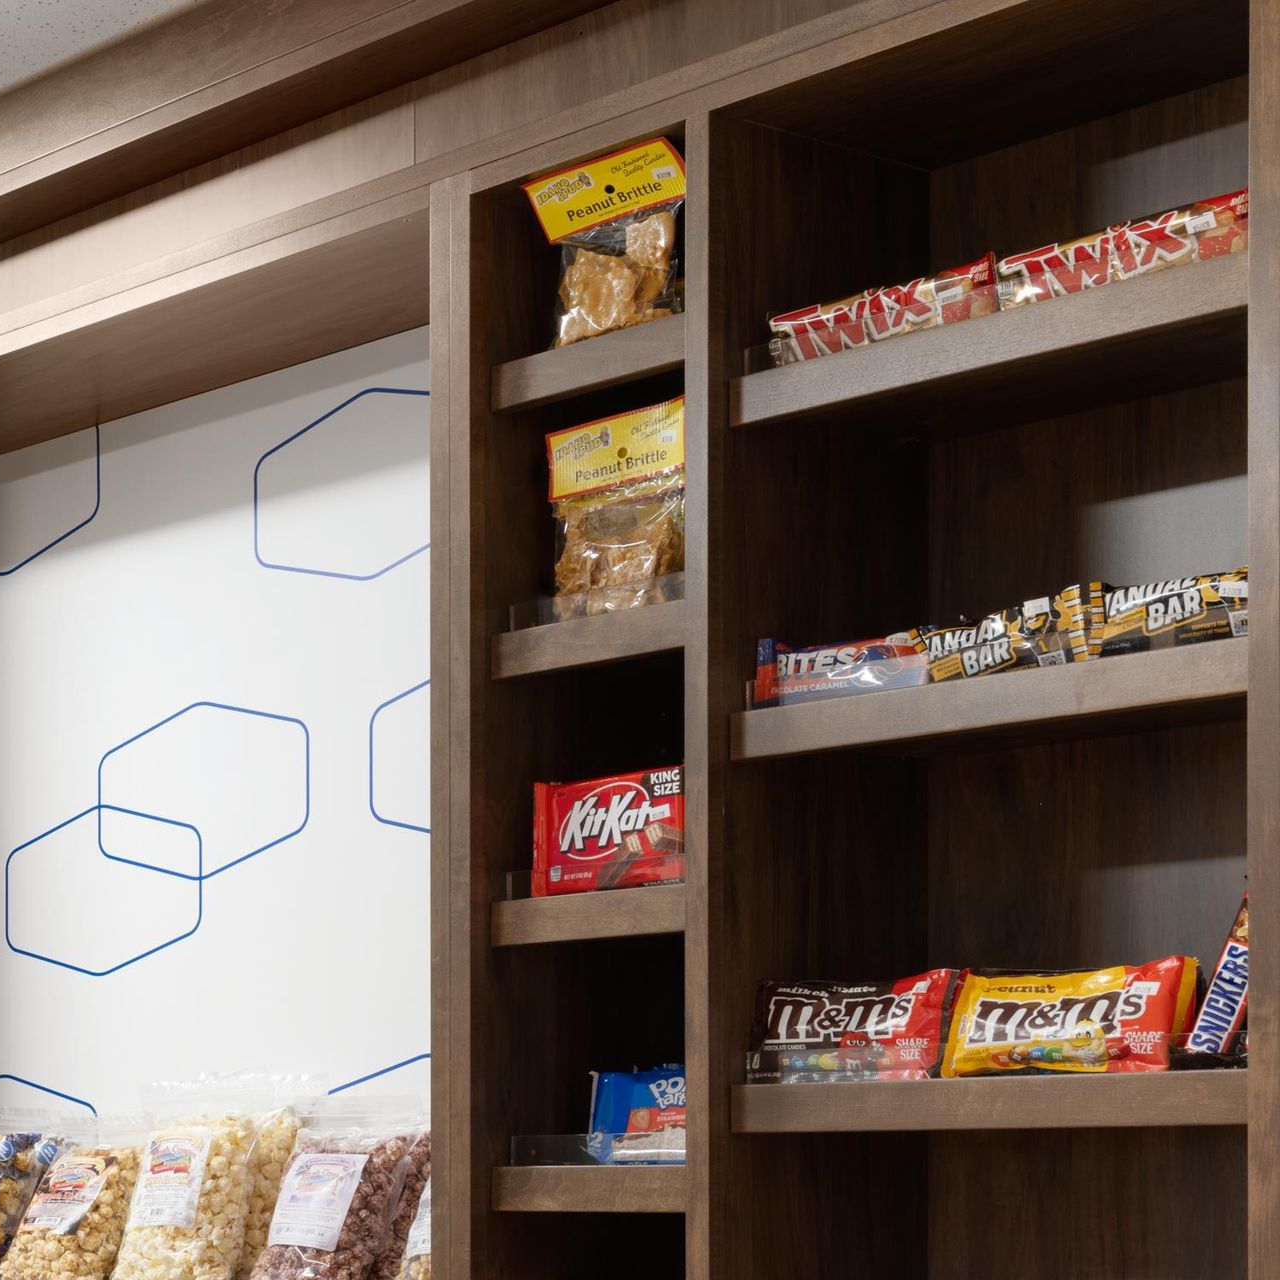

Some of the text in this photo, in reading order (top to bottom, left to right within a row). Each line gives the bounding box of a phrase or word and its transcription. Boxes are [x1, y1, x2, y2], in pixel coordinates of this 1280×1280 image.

[536, 178, 570, 206] IDAHO
[557, 179, 583, 201] SPUD
[566, 181, 662, 221] Peanut Brittle
[974, 271, 989, 283] SIZE
[555, 433, 591, 461] IDAHO
[575, 449, 667, 482] Peanut Brittle
[1148, 589, 1203, 631] BAR
[777, 647, 858, 679] BITES
[963, 642, 1012, 677] BAR
[810, 680, 849, 692] CARAMEL
[650, 769, 680, 785] KING
[653, 783, 680, 797] SIZE
[895, 1037, 930, 1049] SHARE
[1125, 1031, 1161, 1044] SHARE
[900, 1048, 920, 1060] SIZE
[1130, 1042, 1153, 1054] SIZE
